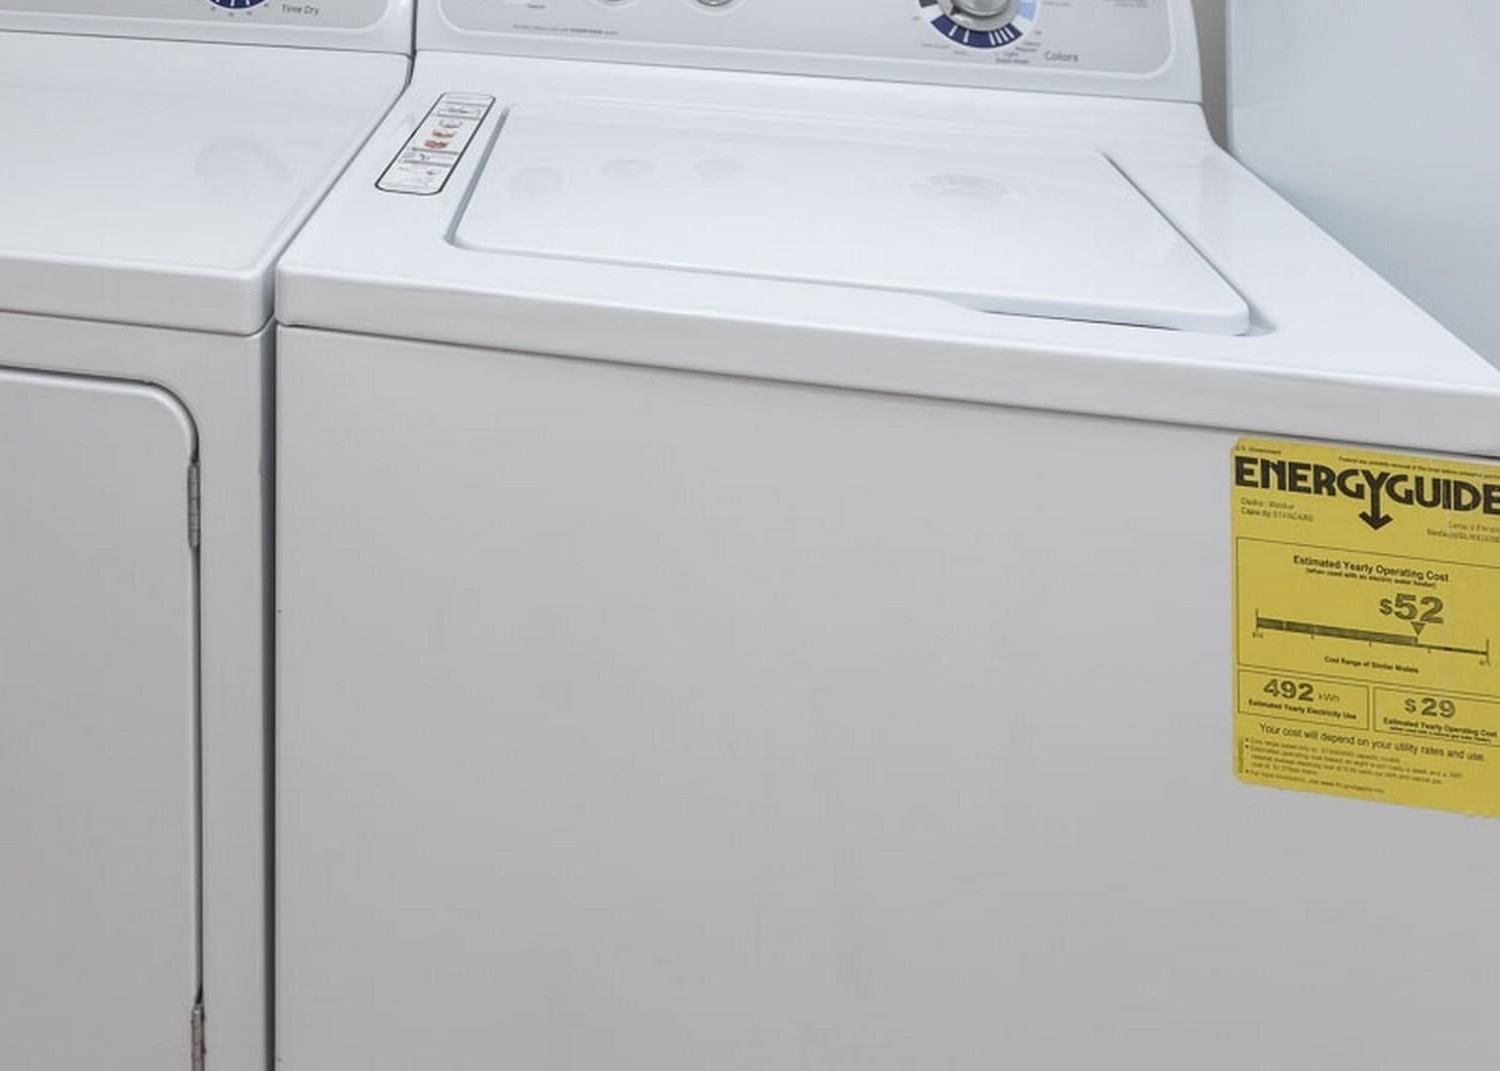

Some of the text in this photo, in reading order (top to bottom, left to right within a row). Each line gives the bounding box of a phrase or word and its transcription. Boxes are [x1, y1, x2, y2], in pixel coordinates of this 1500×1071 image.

[282, 4, 320, 16] Time Dry
[1044, 51, 1079, 63] Colors
[1235, 455, 1500, 526] ENERGYGUIDE
[1293, 555, 1449, 583] Estimated Yearly Operating Cost
[1380, 592, 1444, 624] $52
[1324, 655, 1340, 664] Cost
[1341, 657, 1362, 668] Range
[1372, 662, 1393, 670] Similar
[1394, 664, 1419, 673] Models
[1263, 678, 1341, 702] 492 kWh
[1248, 698, 1357, 720] Estimated Yearly Electricity Use
[1383, 717, 1419, 727] Estimated
[1420, 721, 1443, 732] Yearly
[1444, 724, 1479, 737] Operating
[1480, 729, 1498, 738] Cost
[1260, 722, 1280, 734] Your
[1282, 727, 1302, 737] cost
[1304, 730, 1318, 739] will
[1320, 732, 1355, 744] depend
[1357, 737, 1369, 747] on
[1372, 740, 1392, 750] your
[1394, 742, 1418, 755] utility
[1421, 746, 1444, 757] rates
[1447, 749, 1464, 759] and
